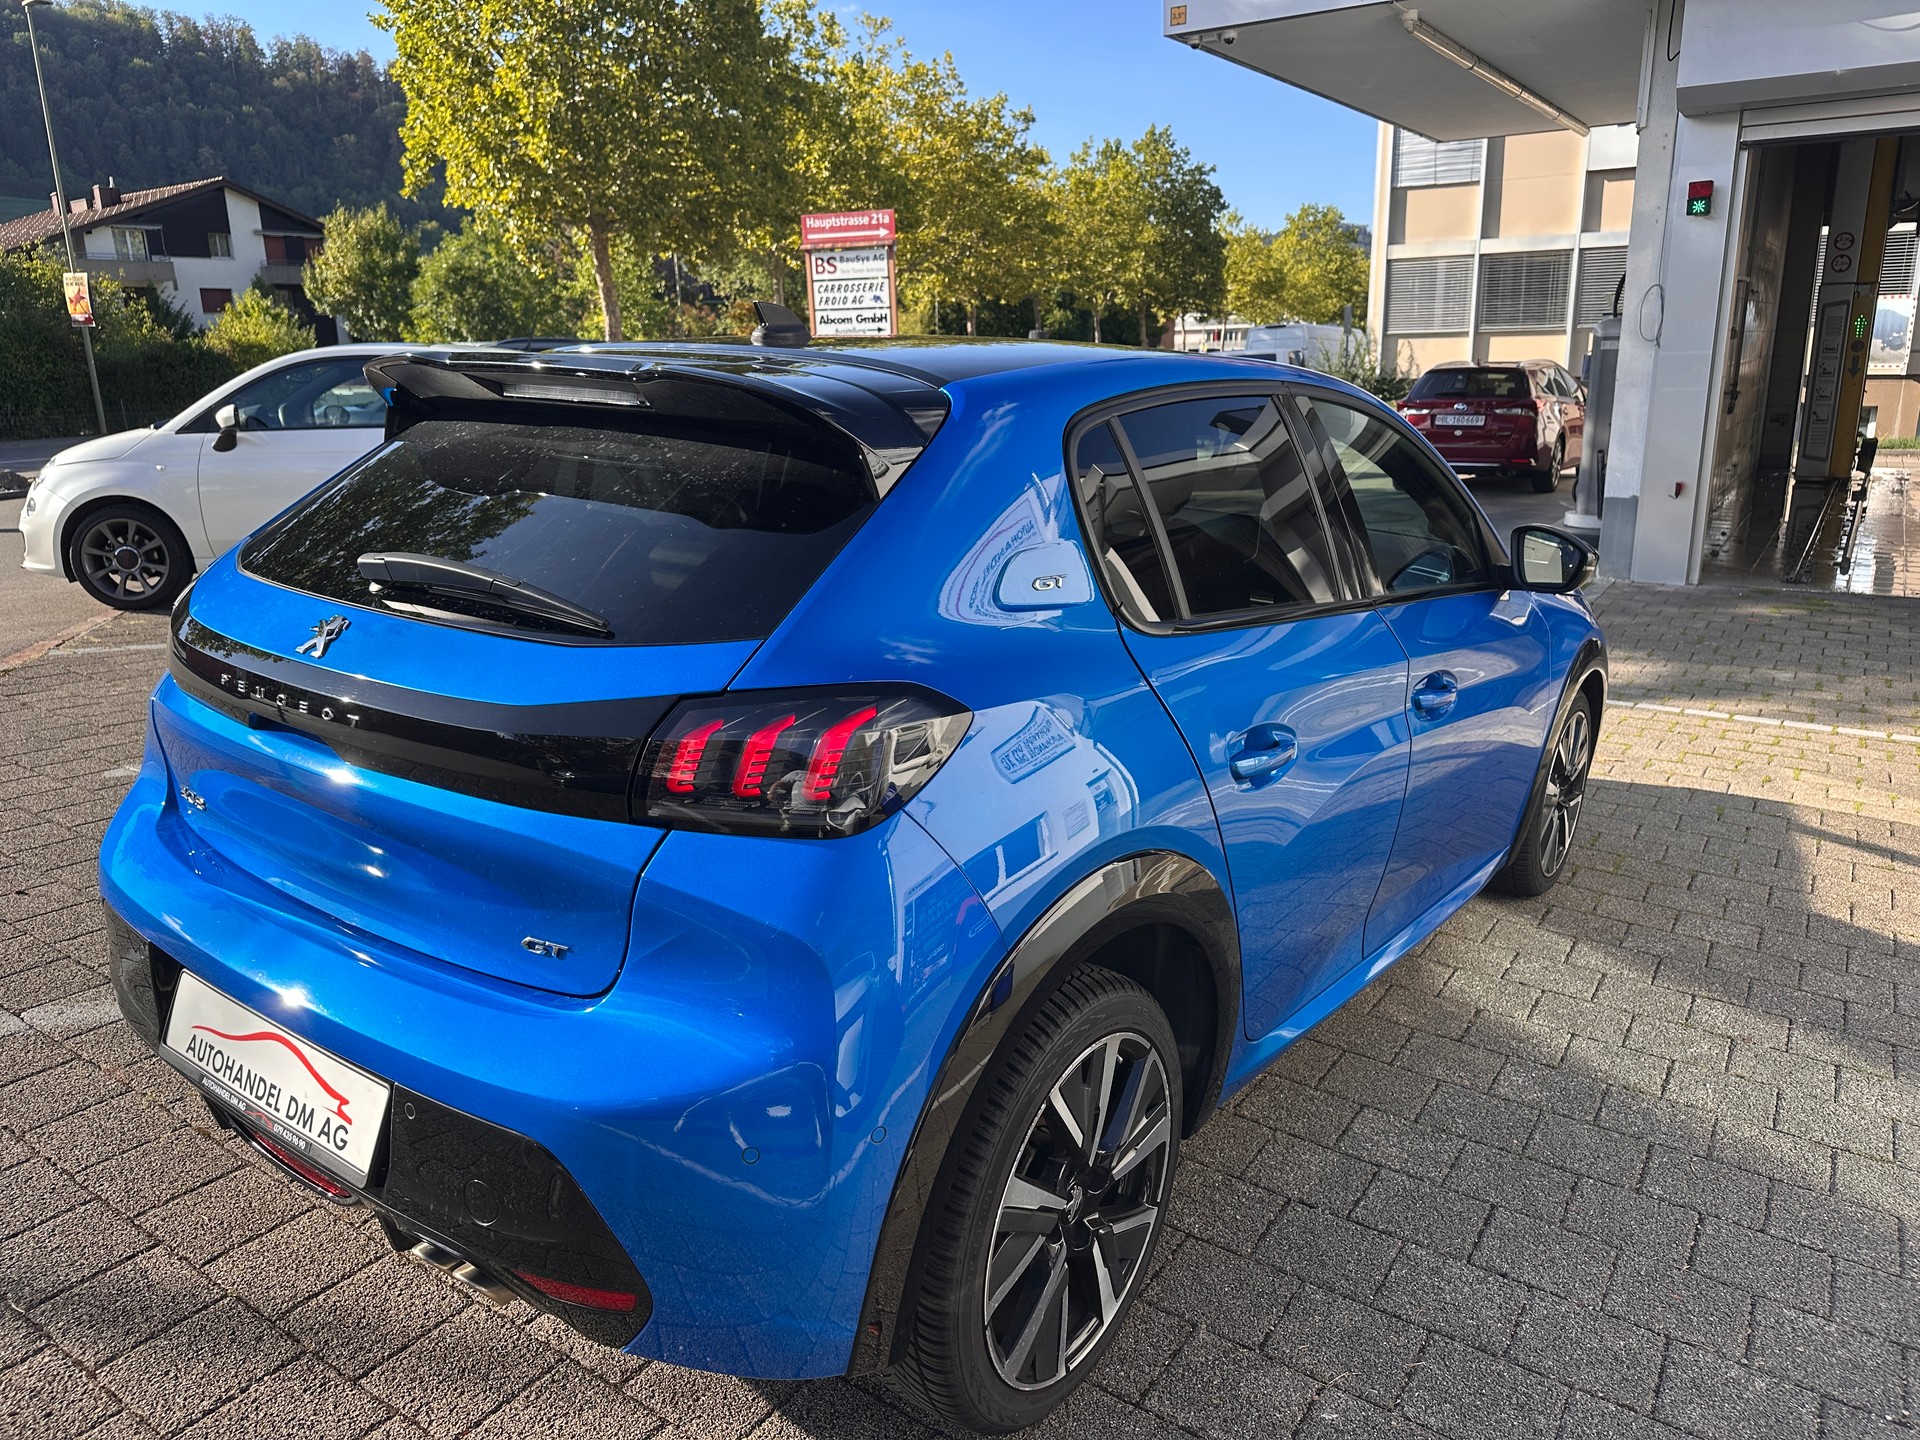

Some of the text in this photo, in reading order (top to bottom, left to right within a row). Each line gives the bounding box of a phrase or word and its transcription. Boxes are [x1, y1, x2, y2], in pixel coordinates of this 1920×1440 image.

[806, 213, 890, 230] Hauptstrasse 21a
[815, 256, 837, 275] BS
[839, 254, 885, 265] BauSys AG
[817, 281, 885, 294] CARROSSERIE
[818, 295, 864, 306] FROIO AG
[819, 313, 888, 325] Abcom GmbH
[1032, 574, 1068, 591] GT
[220, 673, 360, 728] PEUGEOT
[521, 936, 569, 958] GT
[186, 1034, 349, 1151] AUTOHANDEL DM AG
[238, 1101, 247, 1111] AG
